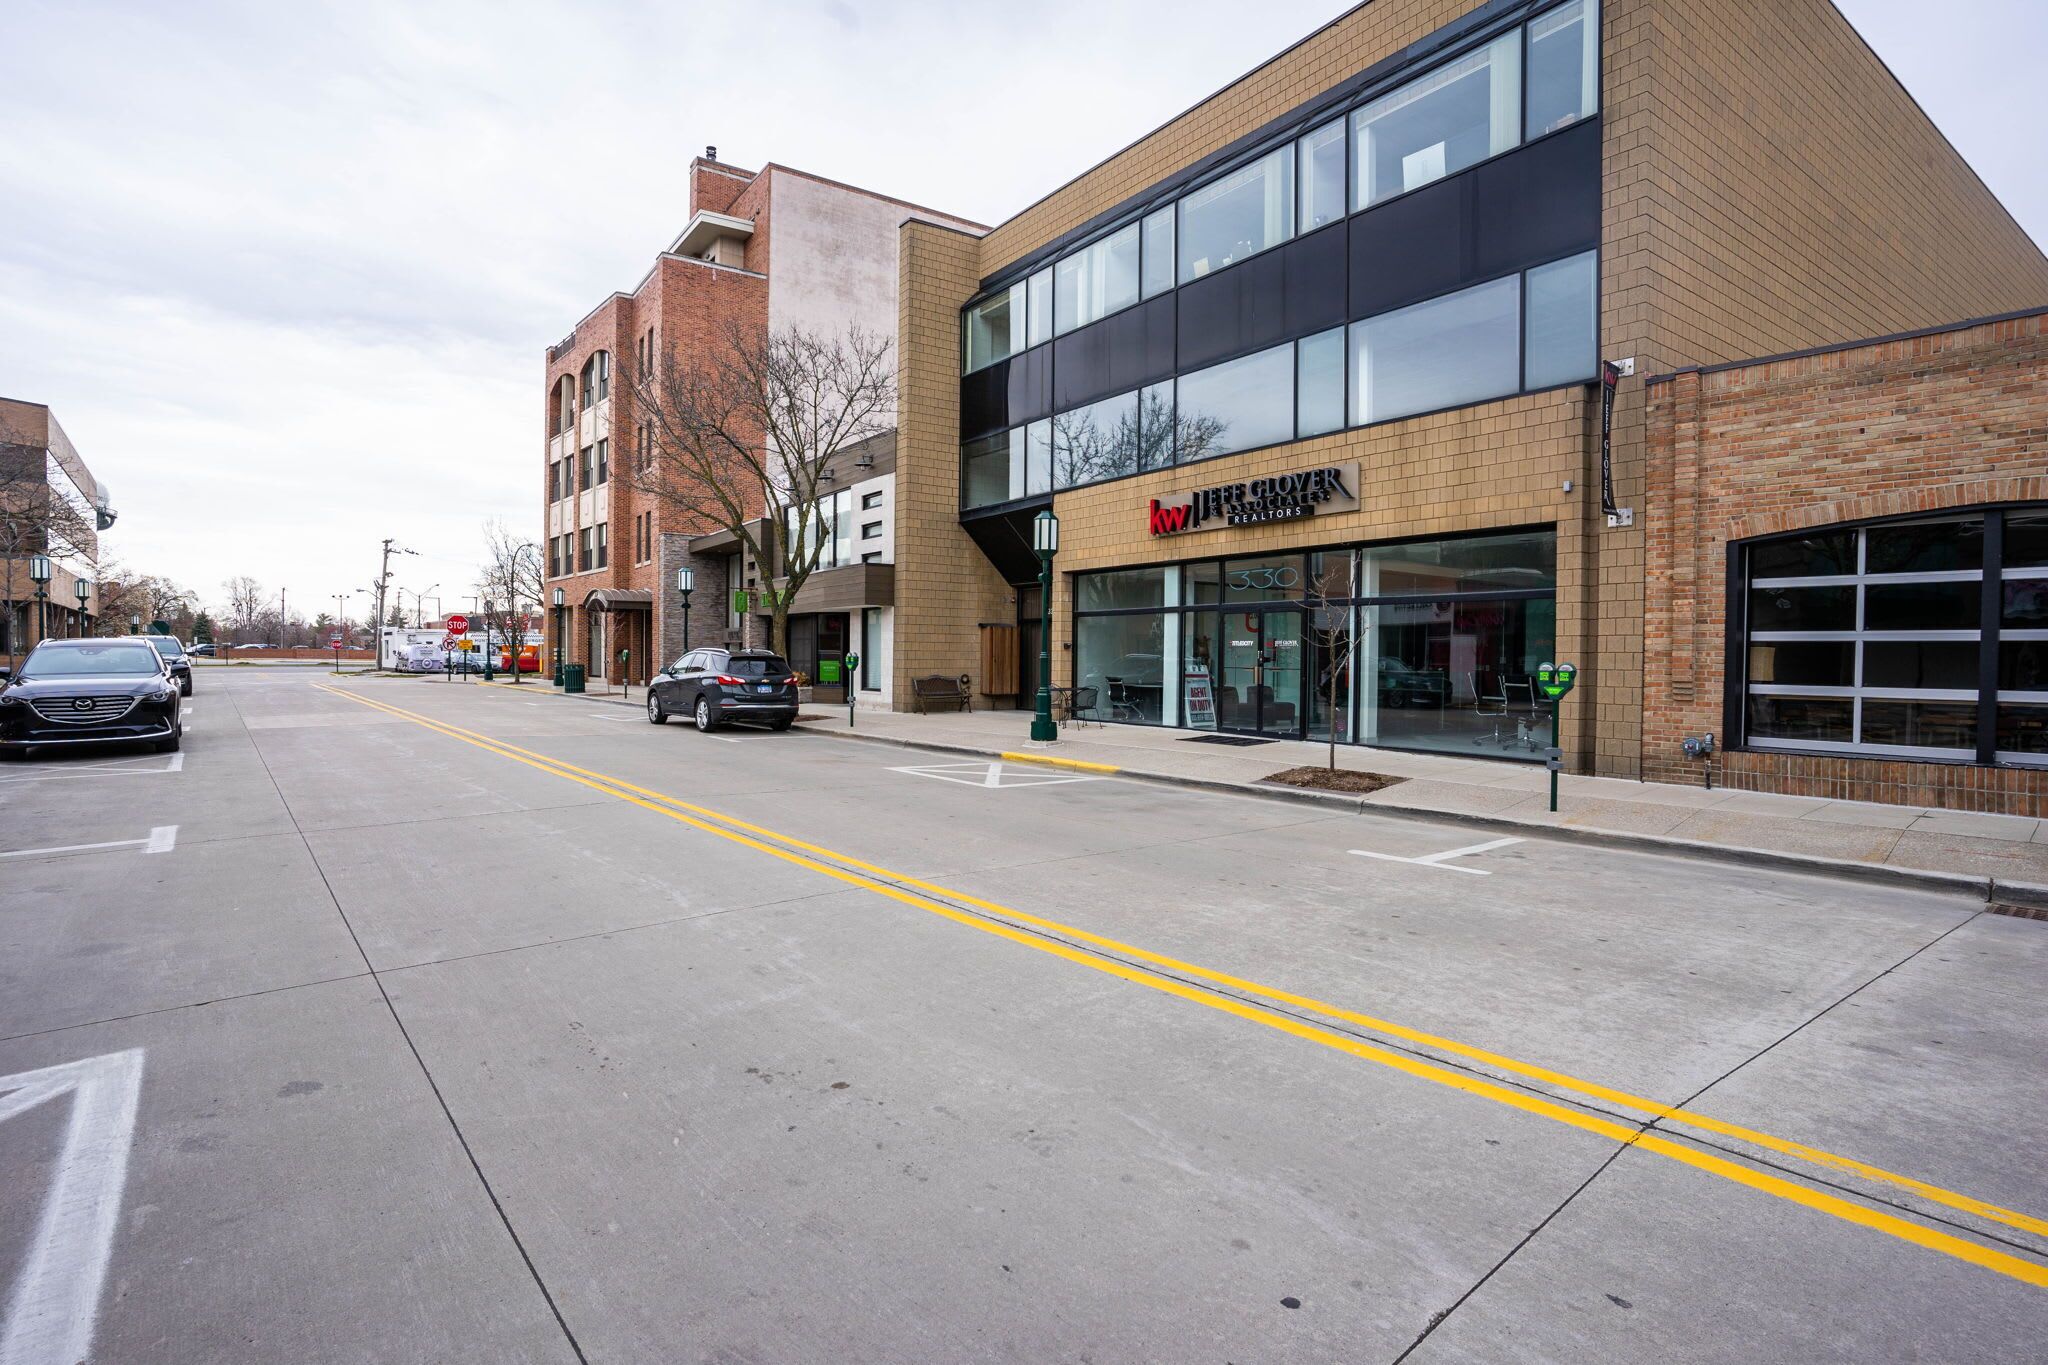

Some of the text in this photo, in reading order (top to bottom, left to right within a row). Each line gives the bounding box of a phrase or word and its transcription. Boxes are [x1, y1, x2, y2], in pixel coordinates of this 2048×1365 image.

[1200, 467, 1354, 521] JEFF GLOVER
[1150, 499, 1191, 536] kw
[1234, 507, 1301, 524] REALTORS
[1229, 567, 1298, 591] 330
[448, 621, 467, 630] STOP
[1191, 687, 1207, 698] AGENT
[1190, 700, 1211, 711] ON DUTY
